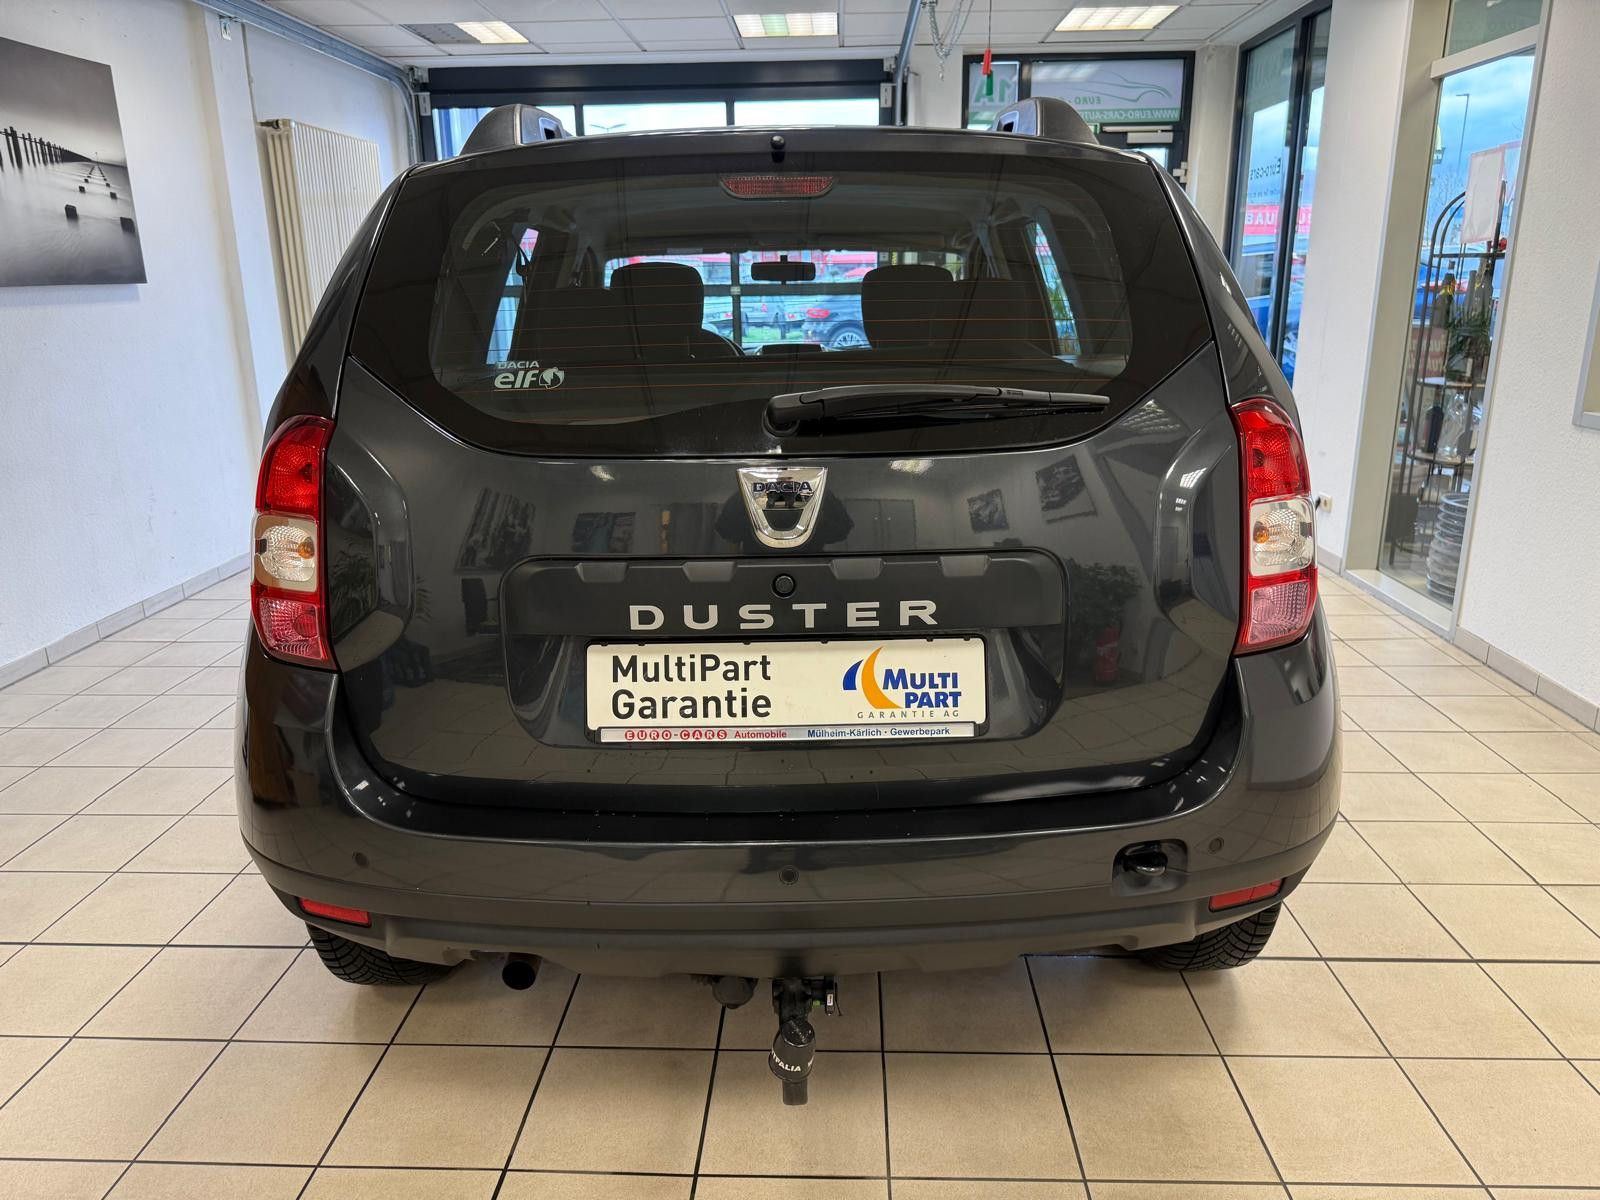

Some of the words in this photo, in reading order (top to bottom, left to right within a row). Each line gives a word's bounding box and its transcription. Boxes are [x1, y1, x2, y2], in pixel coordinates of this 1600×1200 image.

[497, 360, 540, 369] DACIA
[494, 370, 539, 389] elf
[753, 481, 813, 493] DACIA
[629, 600, 938, 630] DUSTER
[612, 654, 771, 683] MultiPart
[882, 668, 959, 690] MULTI
[612, 688, 772, 720] Garantie
[904, 691, 962, 708] PART
[857, 710, 935, 719] GARANTIE
[943, 709, 959, 718] AG
[624, 729, 728, 741] EURO-CARS
[734, 729, 787, 739] Automobile
[807, 728, 882, 738] Mülheim-Kärlich
[890, 726, 951, 737] Gewerbepark
